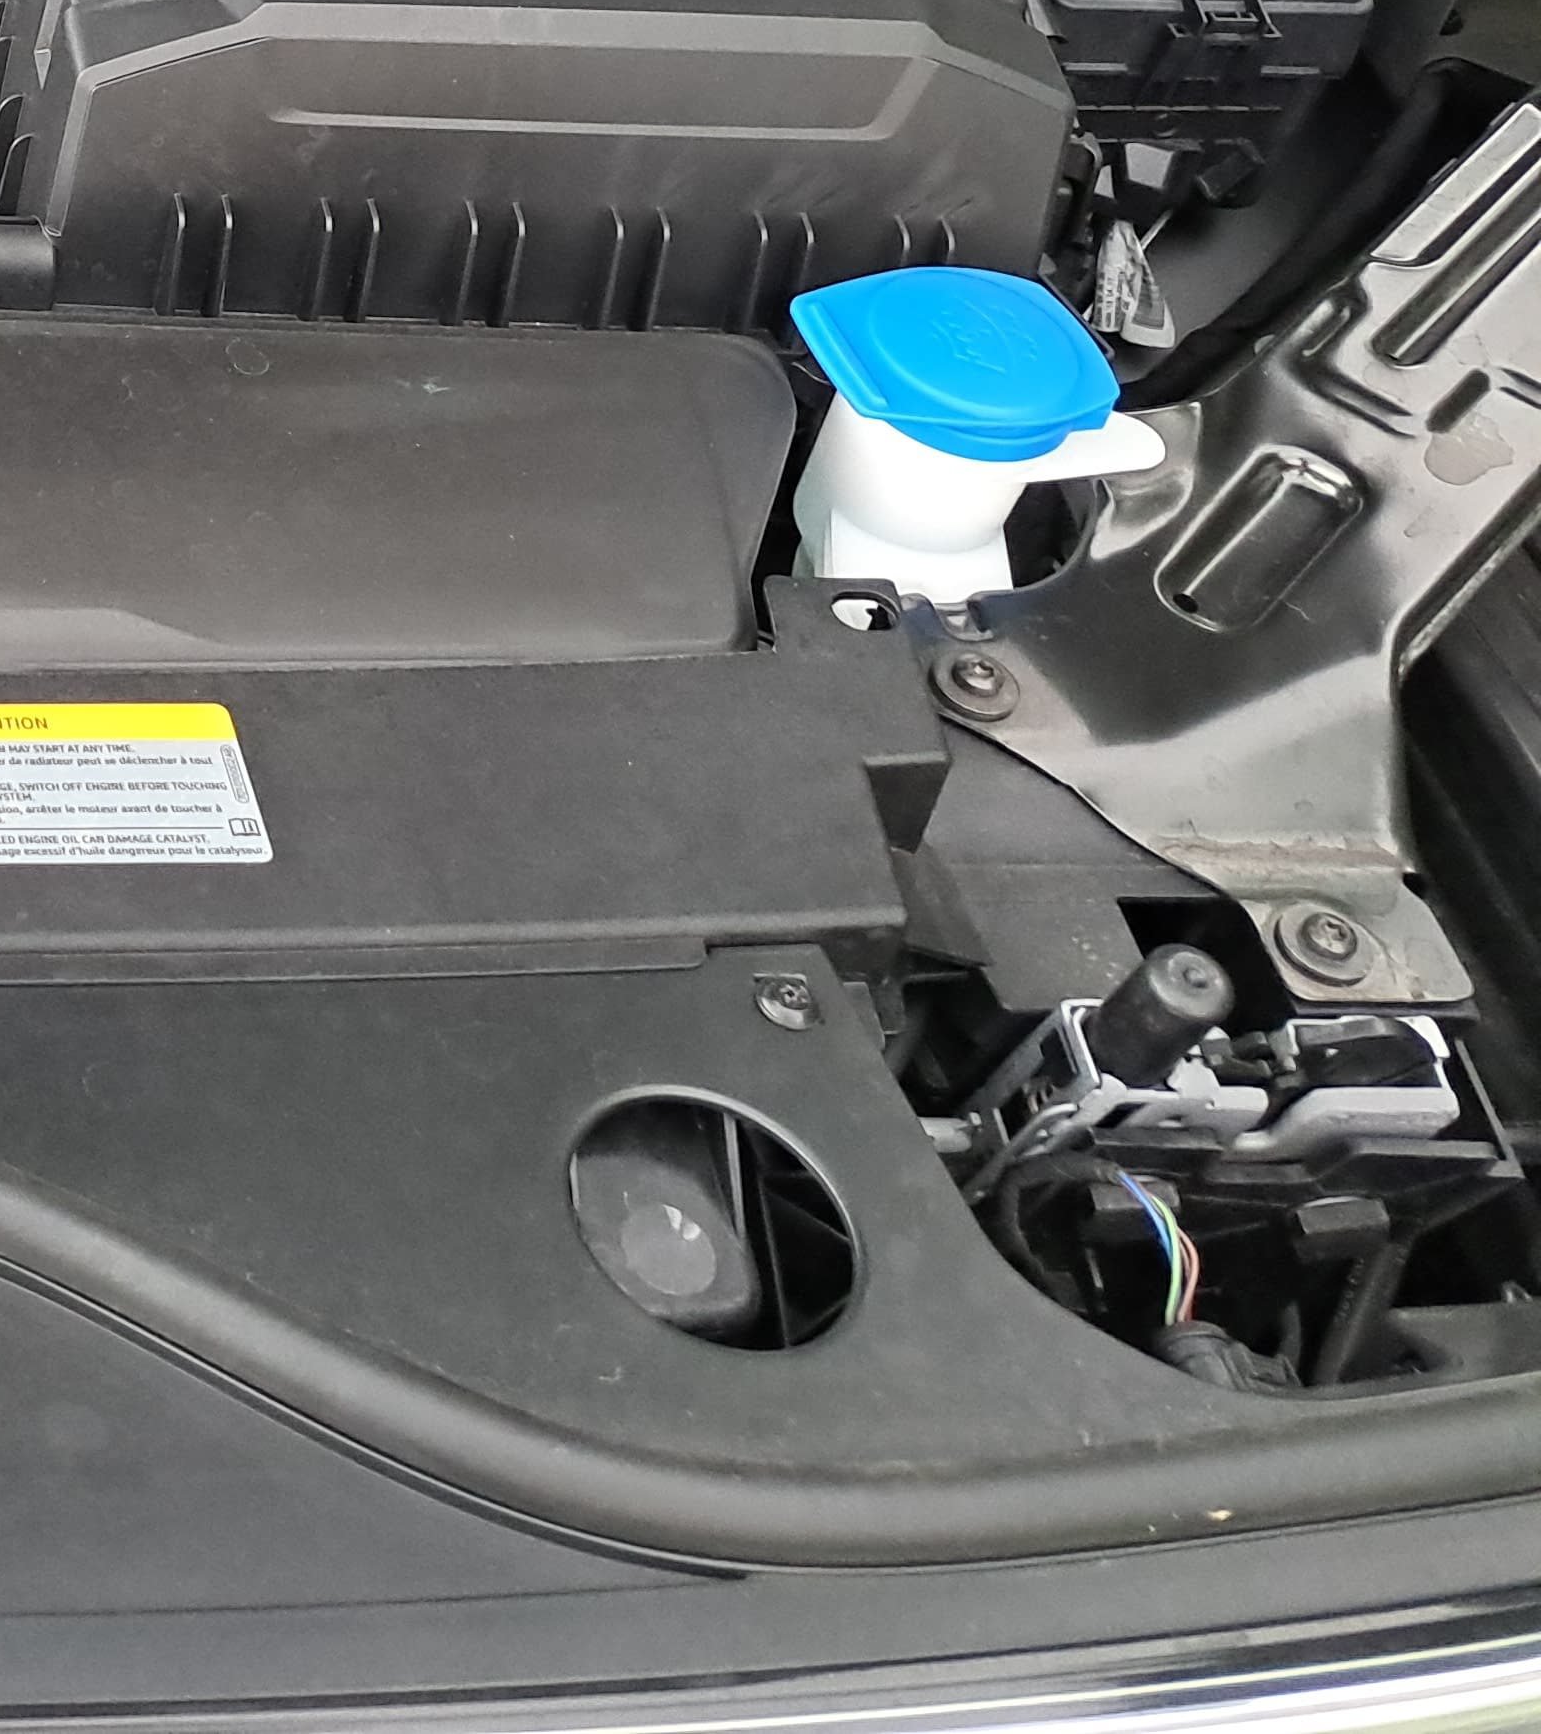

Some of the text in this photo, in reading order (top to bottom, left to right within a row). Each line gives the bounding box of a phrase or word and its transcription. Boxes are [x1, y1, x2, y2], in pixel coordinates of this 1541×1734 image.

[9, 745, 30, 753] MAY
[33, 745, 64, 753] START
[68, 745, 80, 753] AT
[82, 745, 103, 753] ANY
[8, 757, 22, 765] de
[25, 757, 73, 765] radiateur
[19, 783, 59, 791] SWITCH
[62, 783, 82, 791] OFF
[128, 782, 170, 790] BEFORE
[172, 782, 228, 791] TOUCHING
[18, 835, 59, 844] ENGINE
[62, 835, 79, 844] OIL
[107, 835, 154, 843] DAMAGE
